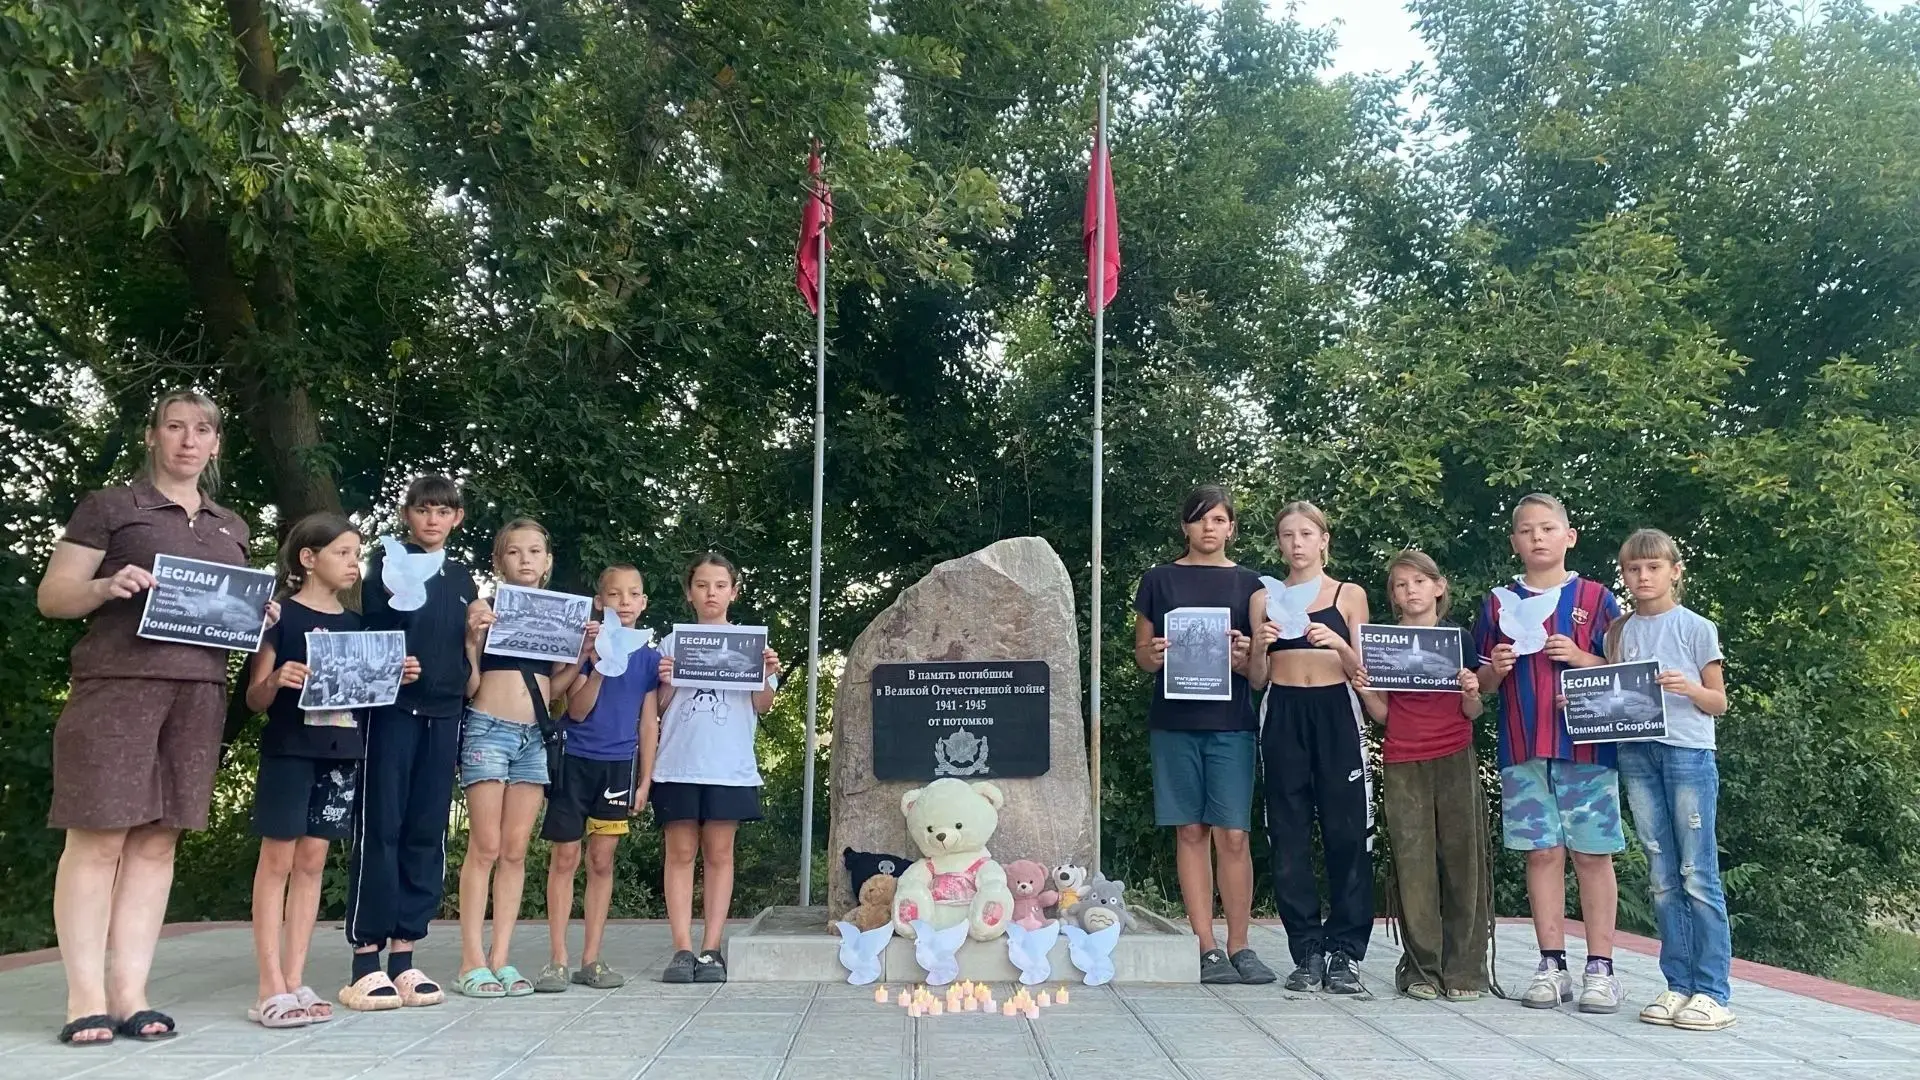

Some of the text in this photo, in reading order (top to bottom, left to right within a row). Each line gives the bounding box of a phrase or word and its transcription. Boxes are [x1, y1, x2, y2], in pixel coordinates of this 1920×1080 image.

[680, 637, 720, 646] БЕСЛАН
[679, 669, 760, 679] Помним! Скорбим!
[908, 669, 1013, 680] В память погибшим
[1369, 675, 1410, 684] омним!
[877, 684, 1045, 696] в Великой Отечественной войне
[935, 700, 956, 711] 1941
[965, 700, 987, 710] 1945
[928, 717, 994, 726] от потомков
[1365, 761, 1373, 783] NIKE
